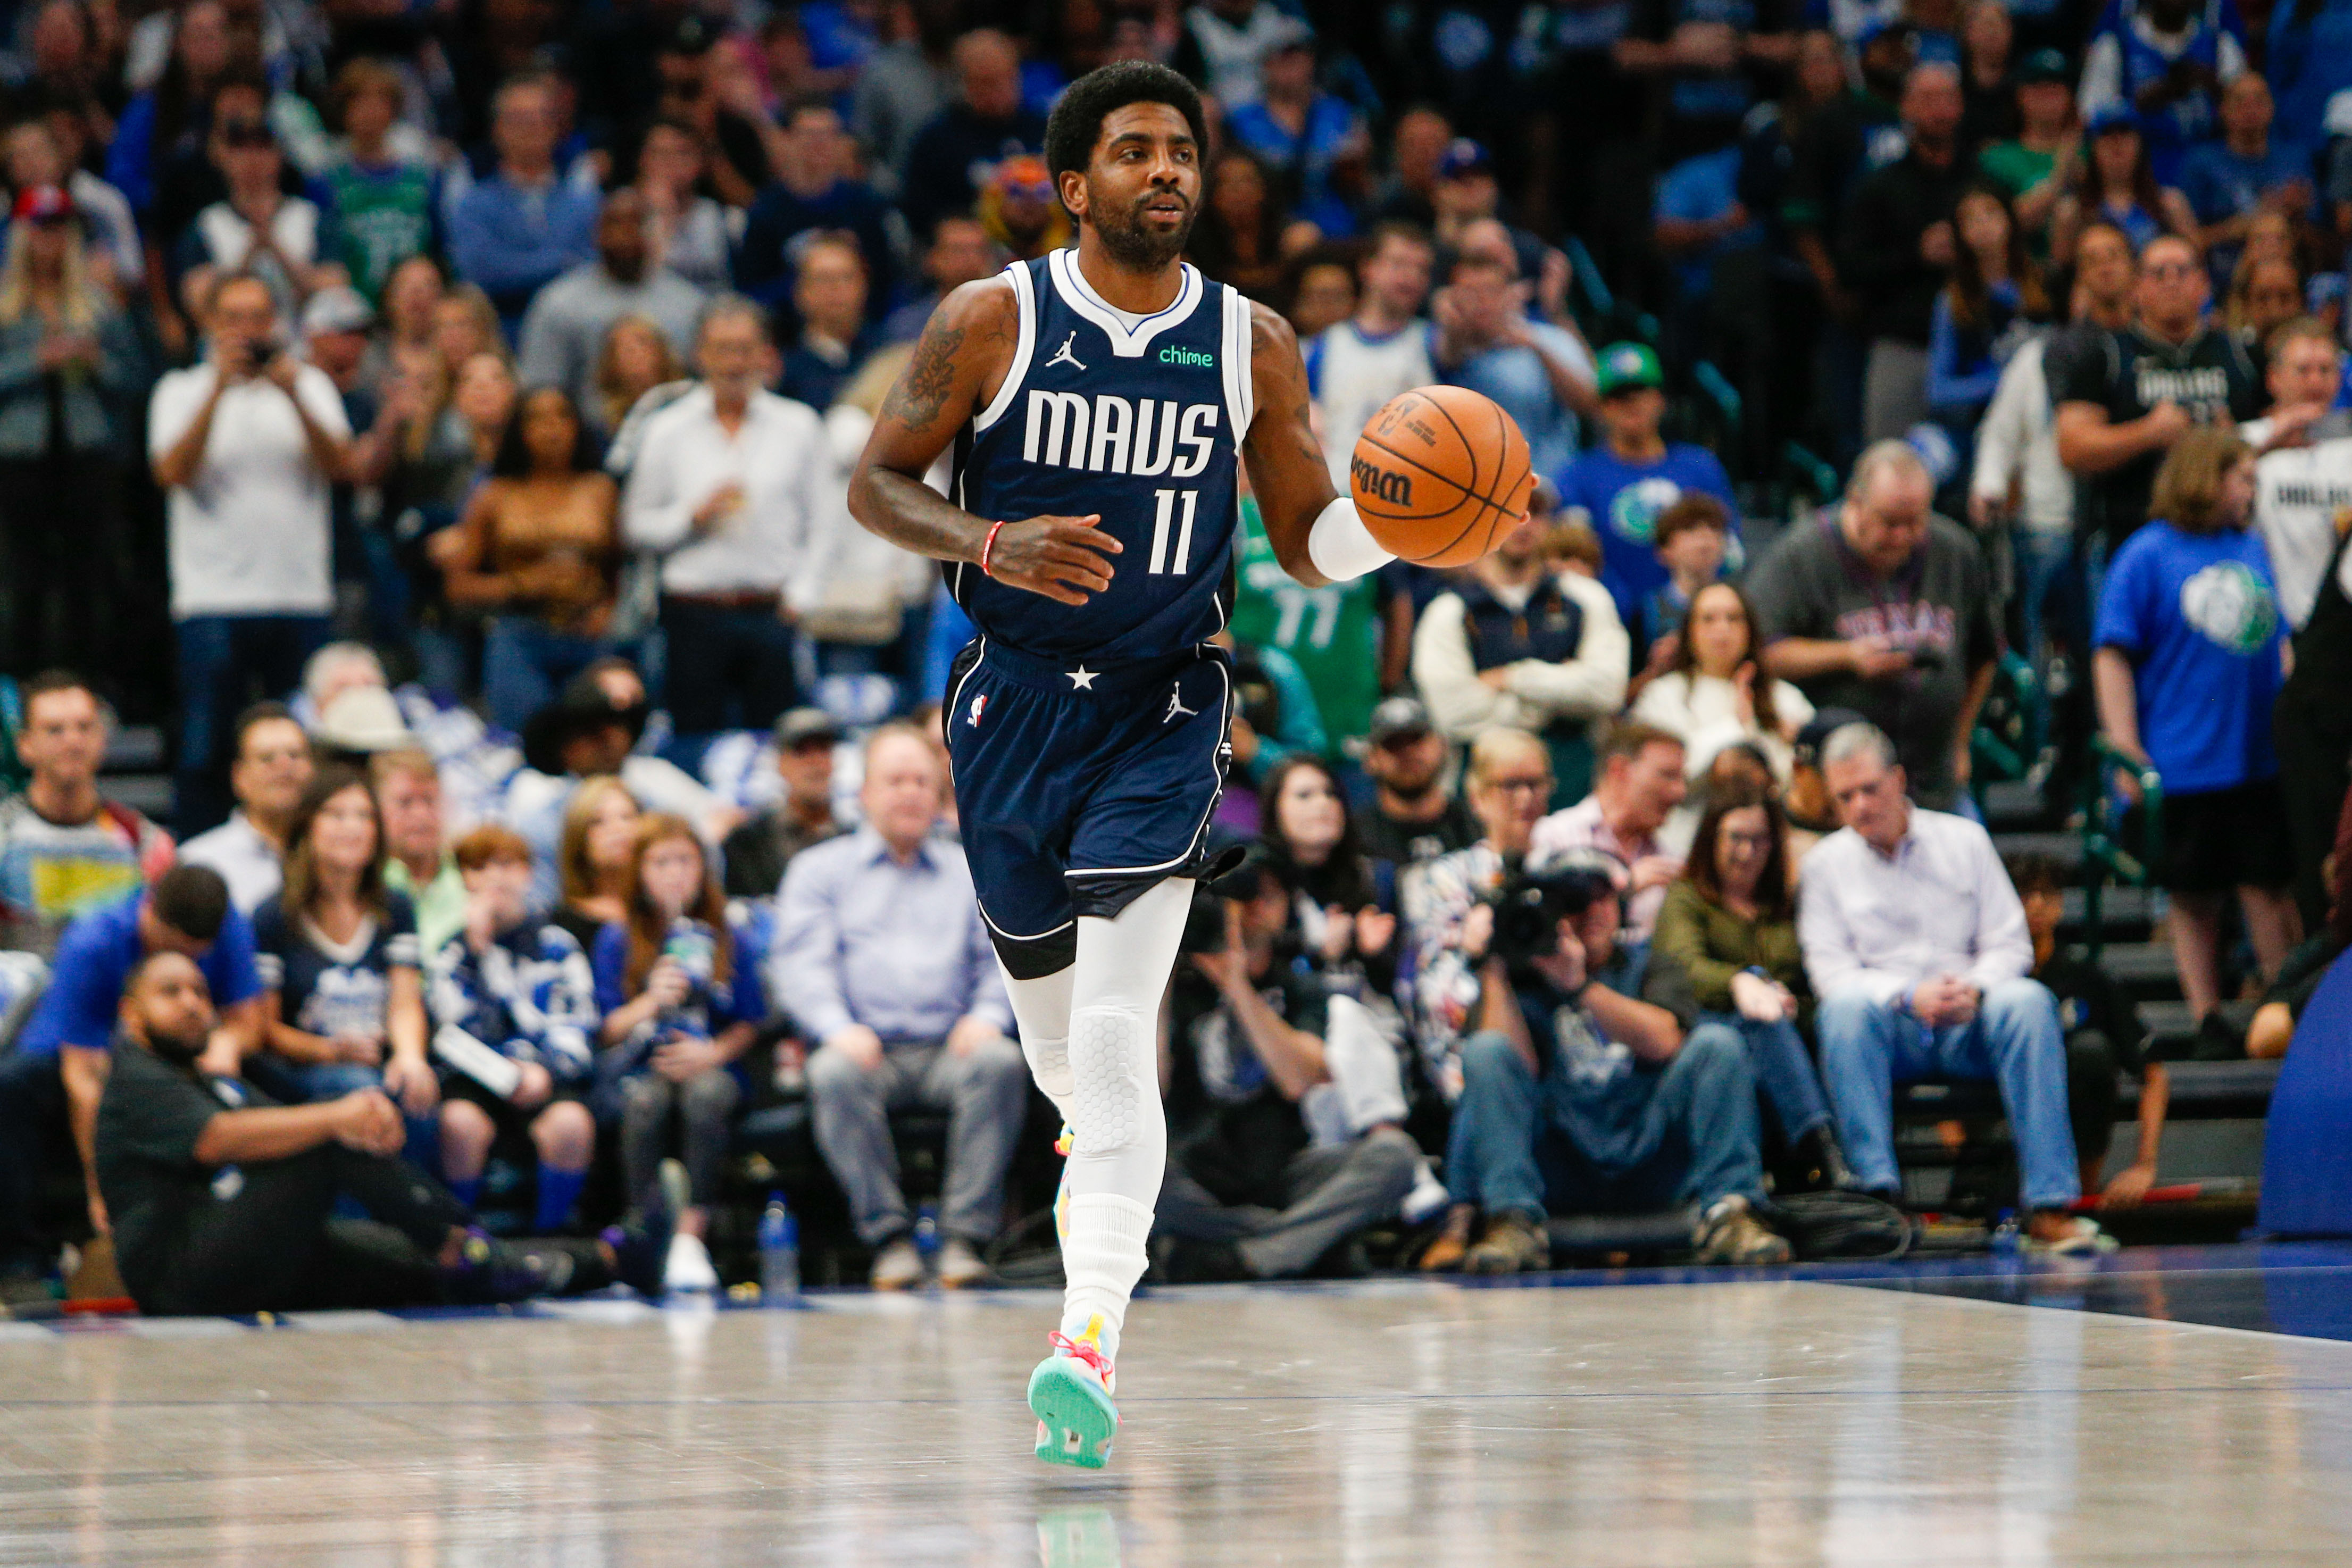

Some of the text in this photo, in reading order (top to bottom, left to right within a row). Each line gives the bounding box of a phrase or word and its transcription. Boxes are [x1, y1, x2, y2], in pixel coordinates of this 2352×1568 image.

[1160, 345, 1213, 367] chime
[1024, 390, 1219, 478] MAVS
[1351, 454, 1413, 507] Wilso
[1149, 489, 1198, 575] 11
